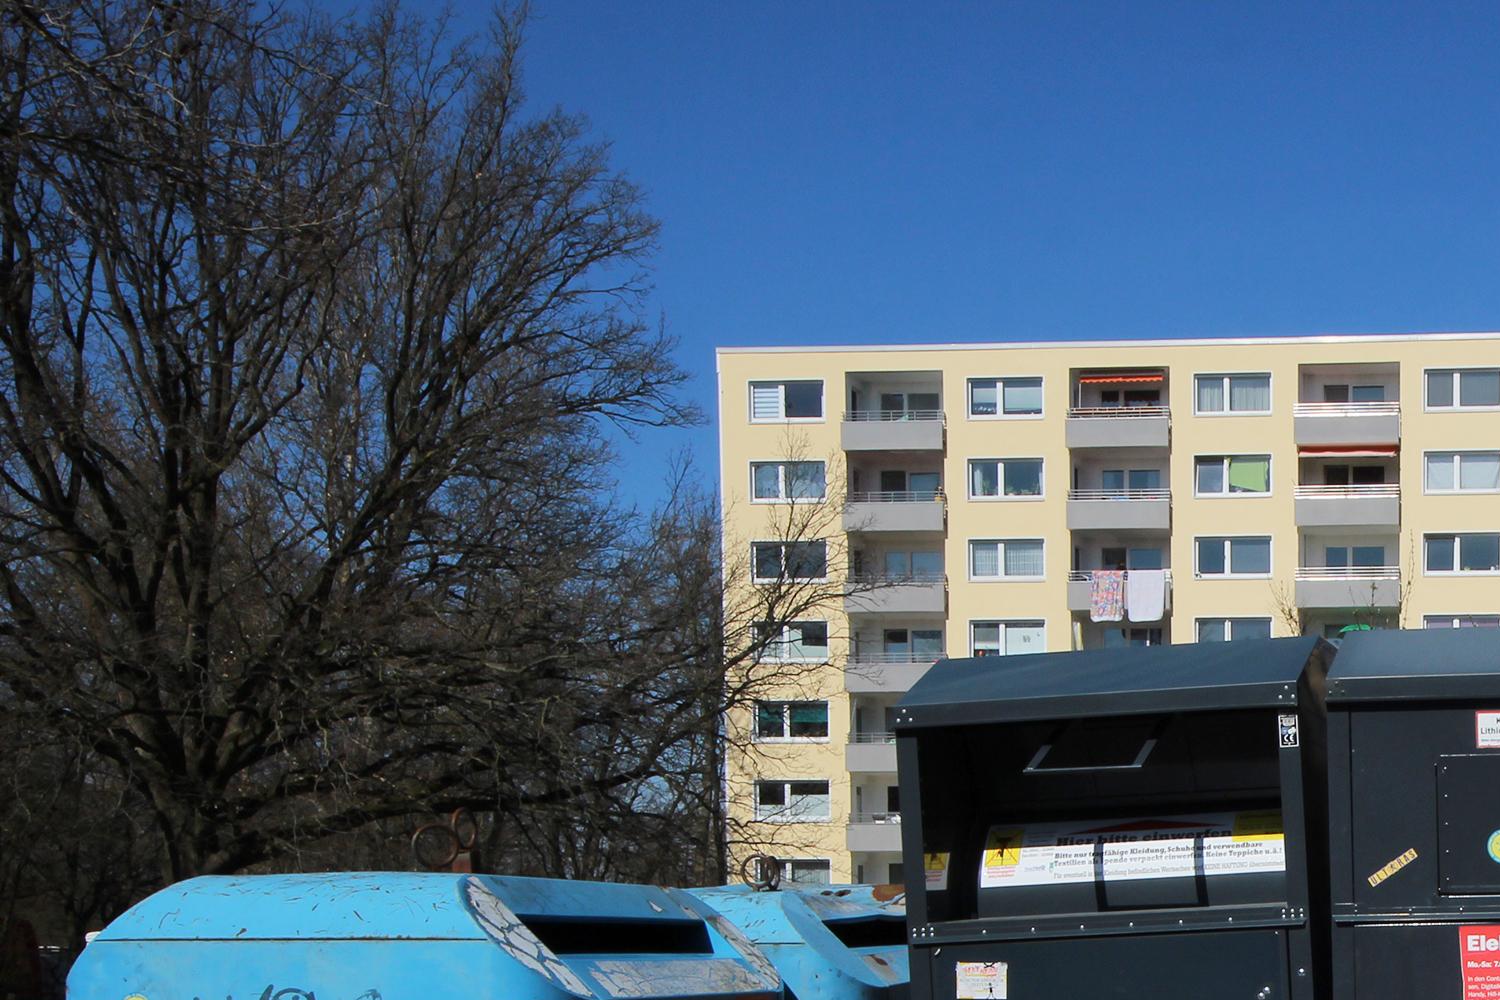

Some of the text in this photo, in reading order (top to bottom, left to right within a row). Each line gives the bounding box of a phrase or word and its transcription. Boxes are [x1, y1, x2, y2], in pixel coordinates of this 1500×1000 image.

[1055, 851, 1073, 859] Bitte
[1213, 842, 1263, 850] verwendbare
[1205, 850, 1227, 858] Keine
[1229, 849, 1264, 858] Teppiche
